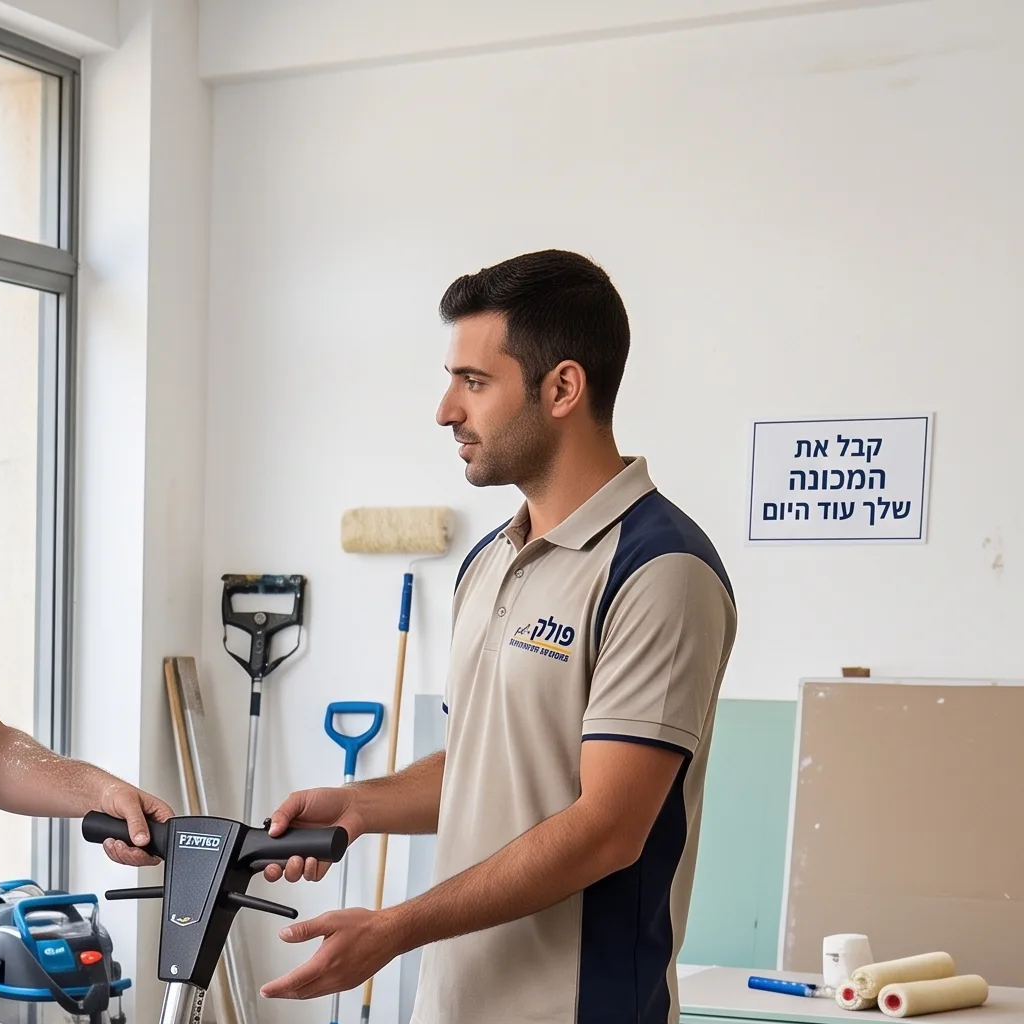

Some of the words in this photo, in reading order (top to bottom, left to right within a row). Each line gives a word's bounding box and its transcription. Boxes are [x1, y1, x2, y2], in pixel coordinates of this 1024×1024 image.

[794, 439, 829, 458] את
[836, 434, 883, 463] קבל
[789, 468, 886, 490] המכונה
[762, 501, 810, 521] היום
[817, 501, 855, 520] עוד
[862, 496, 911, 526] שלך
[530, 615, 575, 647] פולק
